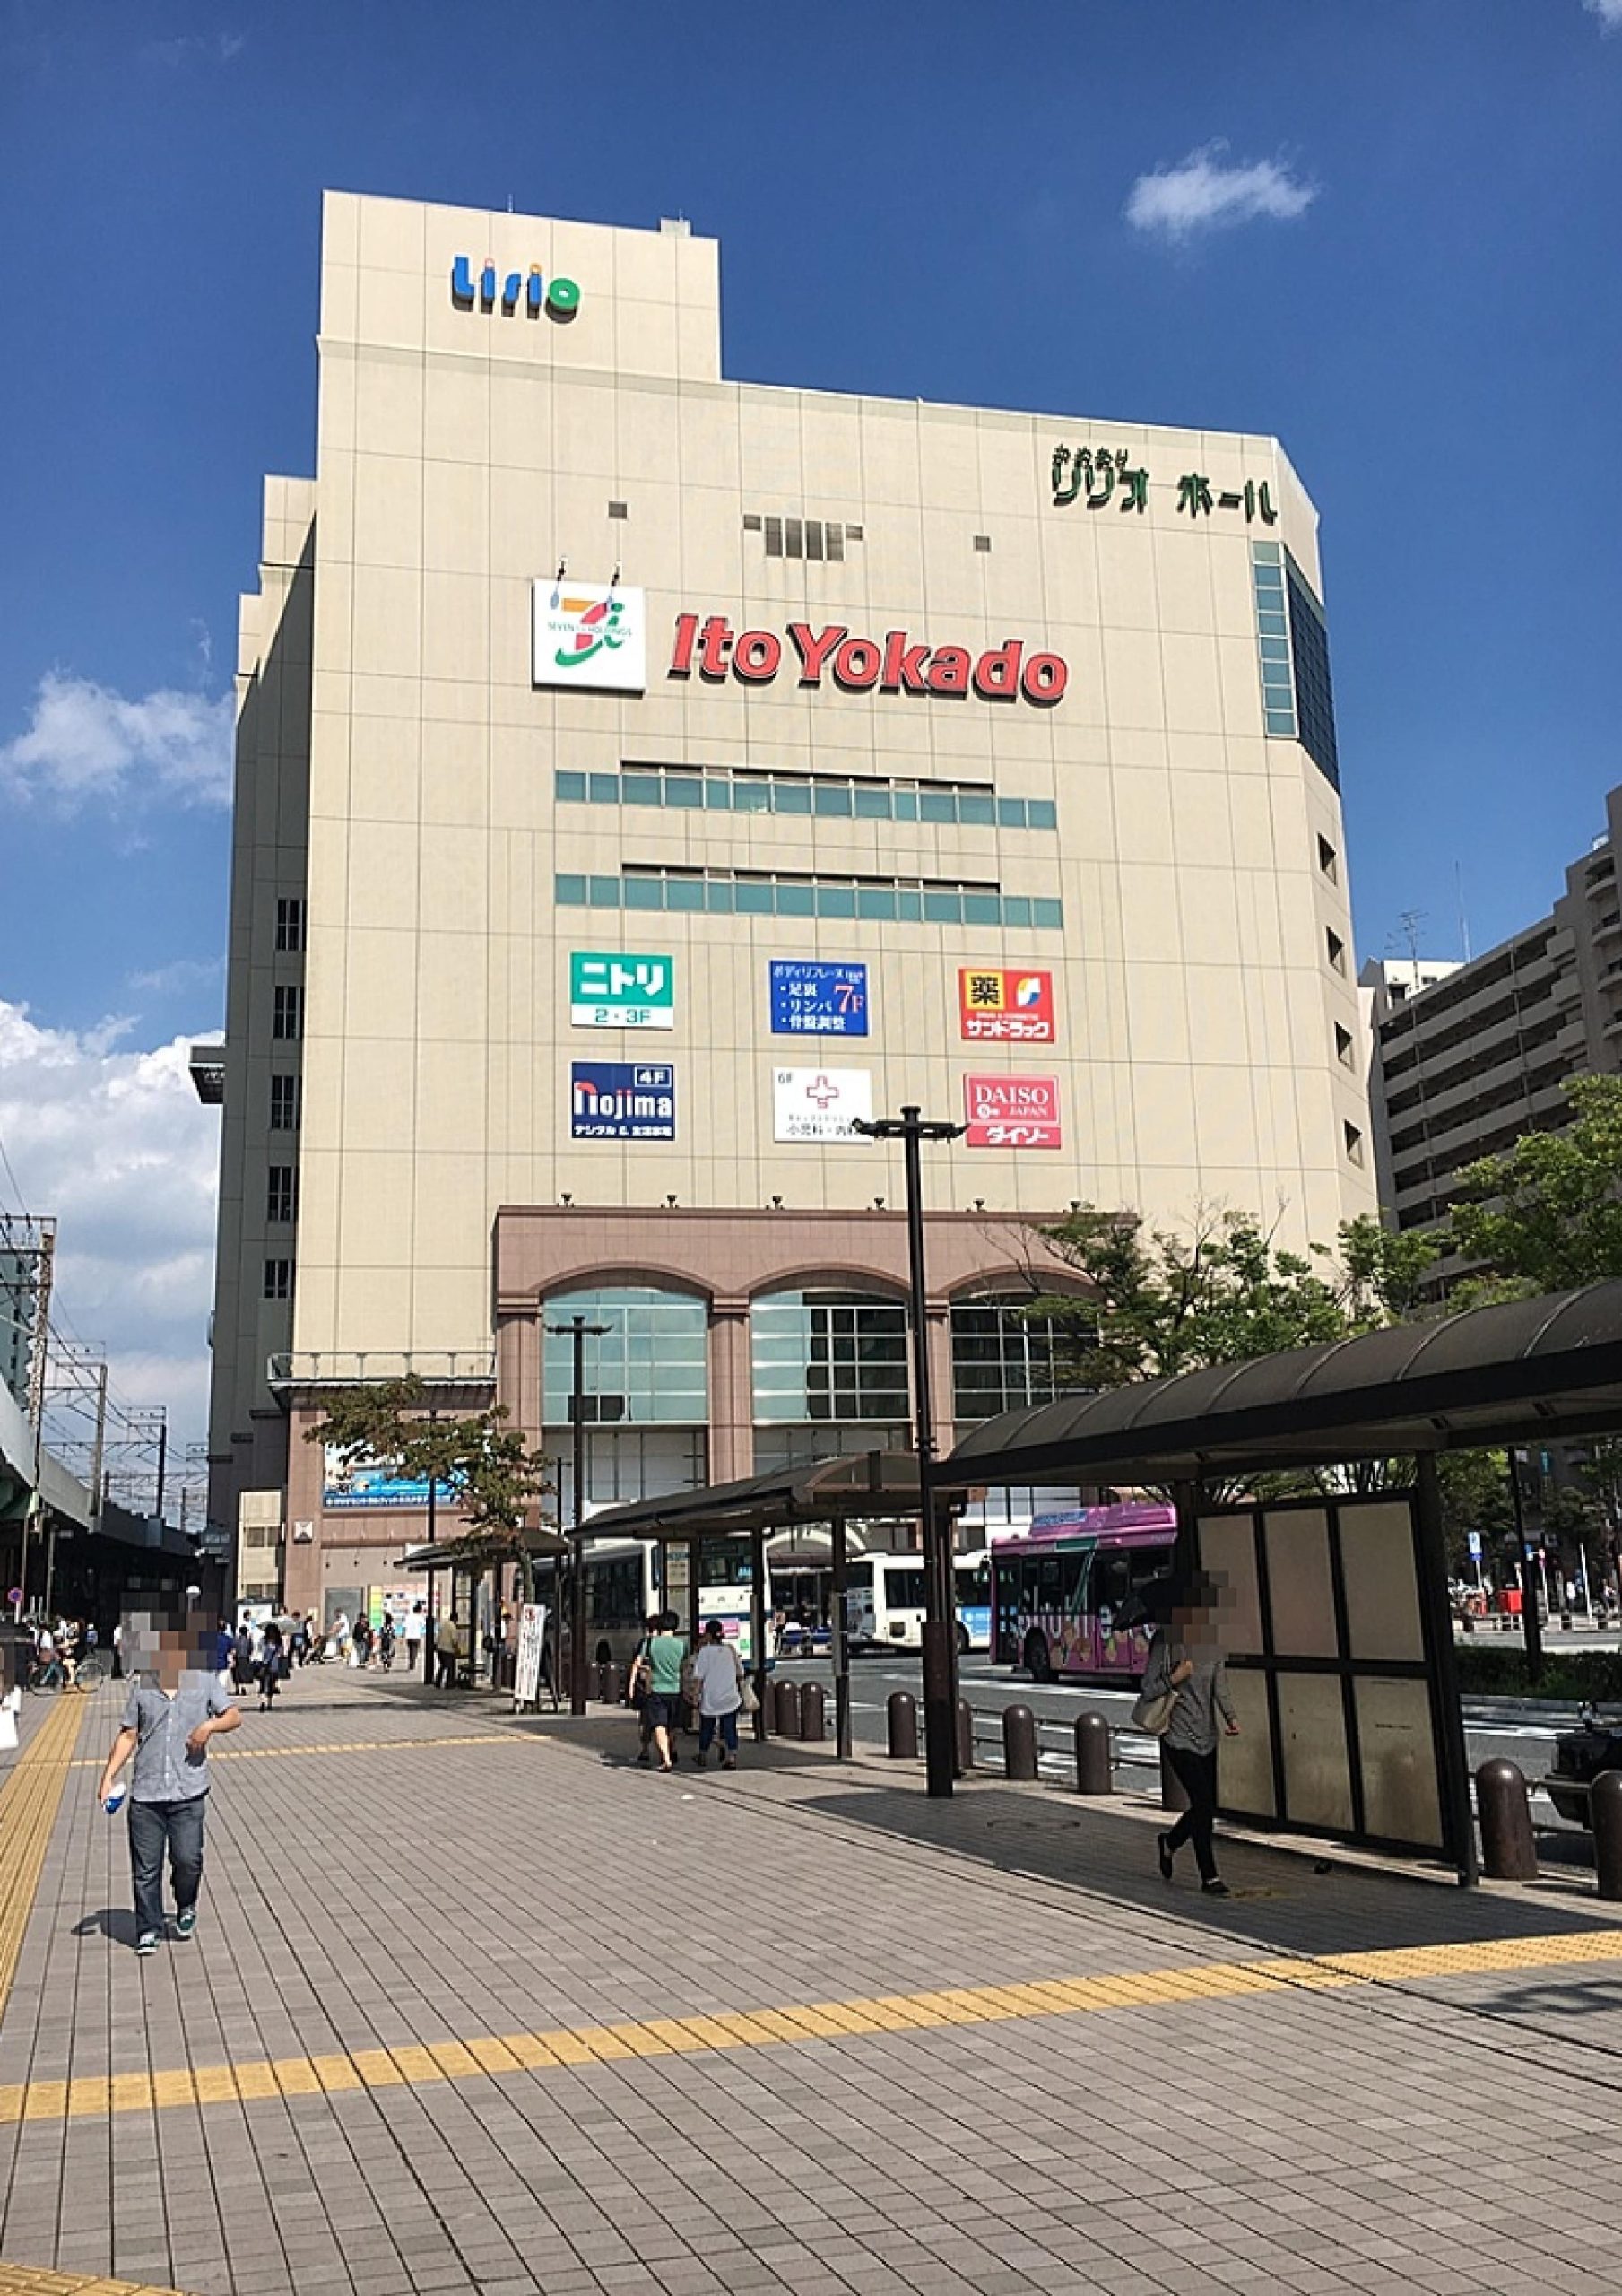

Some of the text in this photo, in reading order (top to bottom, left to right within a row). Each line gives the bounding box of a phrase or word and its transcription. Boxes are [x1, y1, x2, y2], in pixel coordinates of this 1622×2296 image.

[1053, 461, 1277, 526] リリオ ホール
[668, 613, 1069, 709] Ito Yokado
[580, 961, 664, 997] ニトリ
[970, 976, 1000, 1005] 薬
[638, 1069, 664, 1083] 4F
[976, 1085, 1049, 1105] DAISO
[1009, 1106, 1047, 1118] JAPAN
[987, 1125, 1049, 1144] ダイソー
